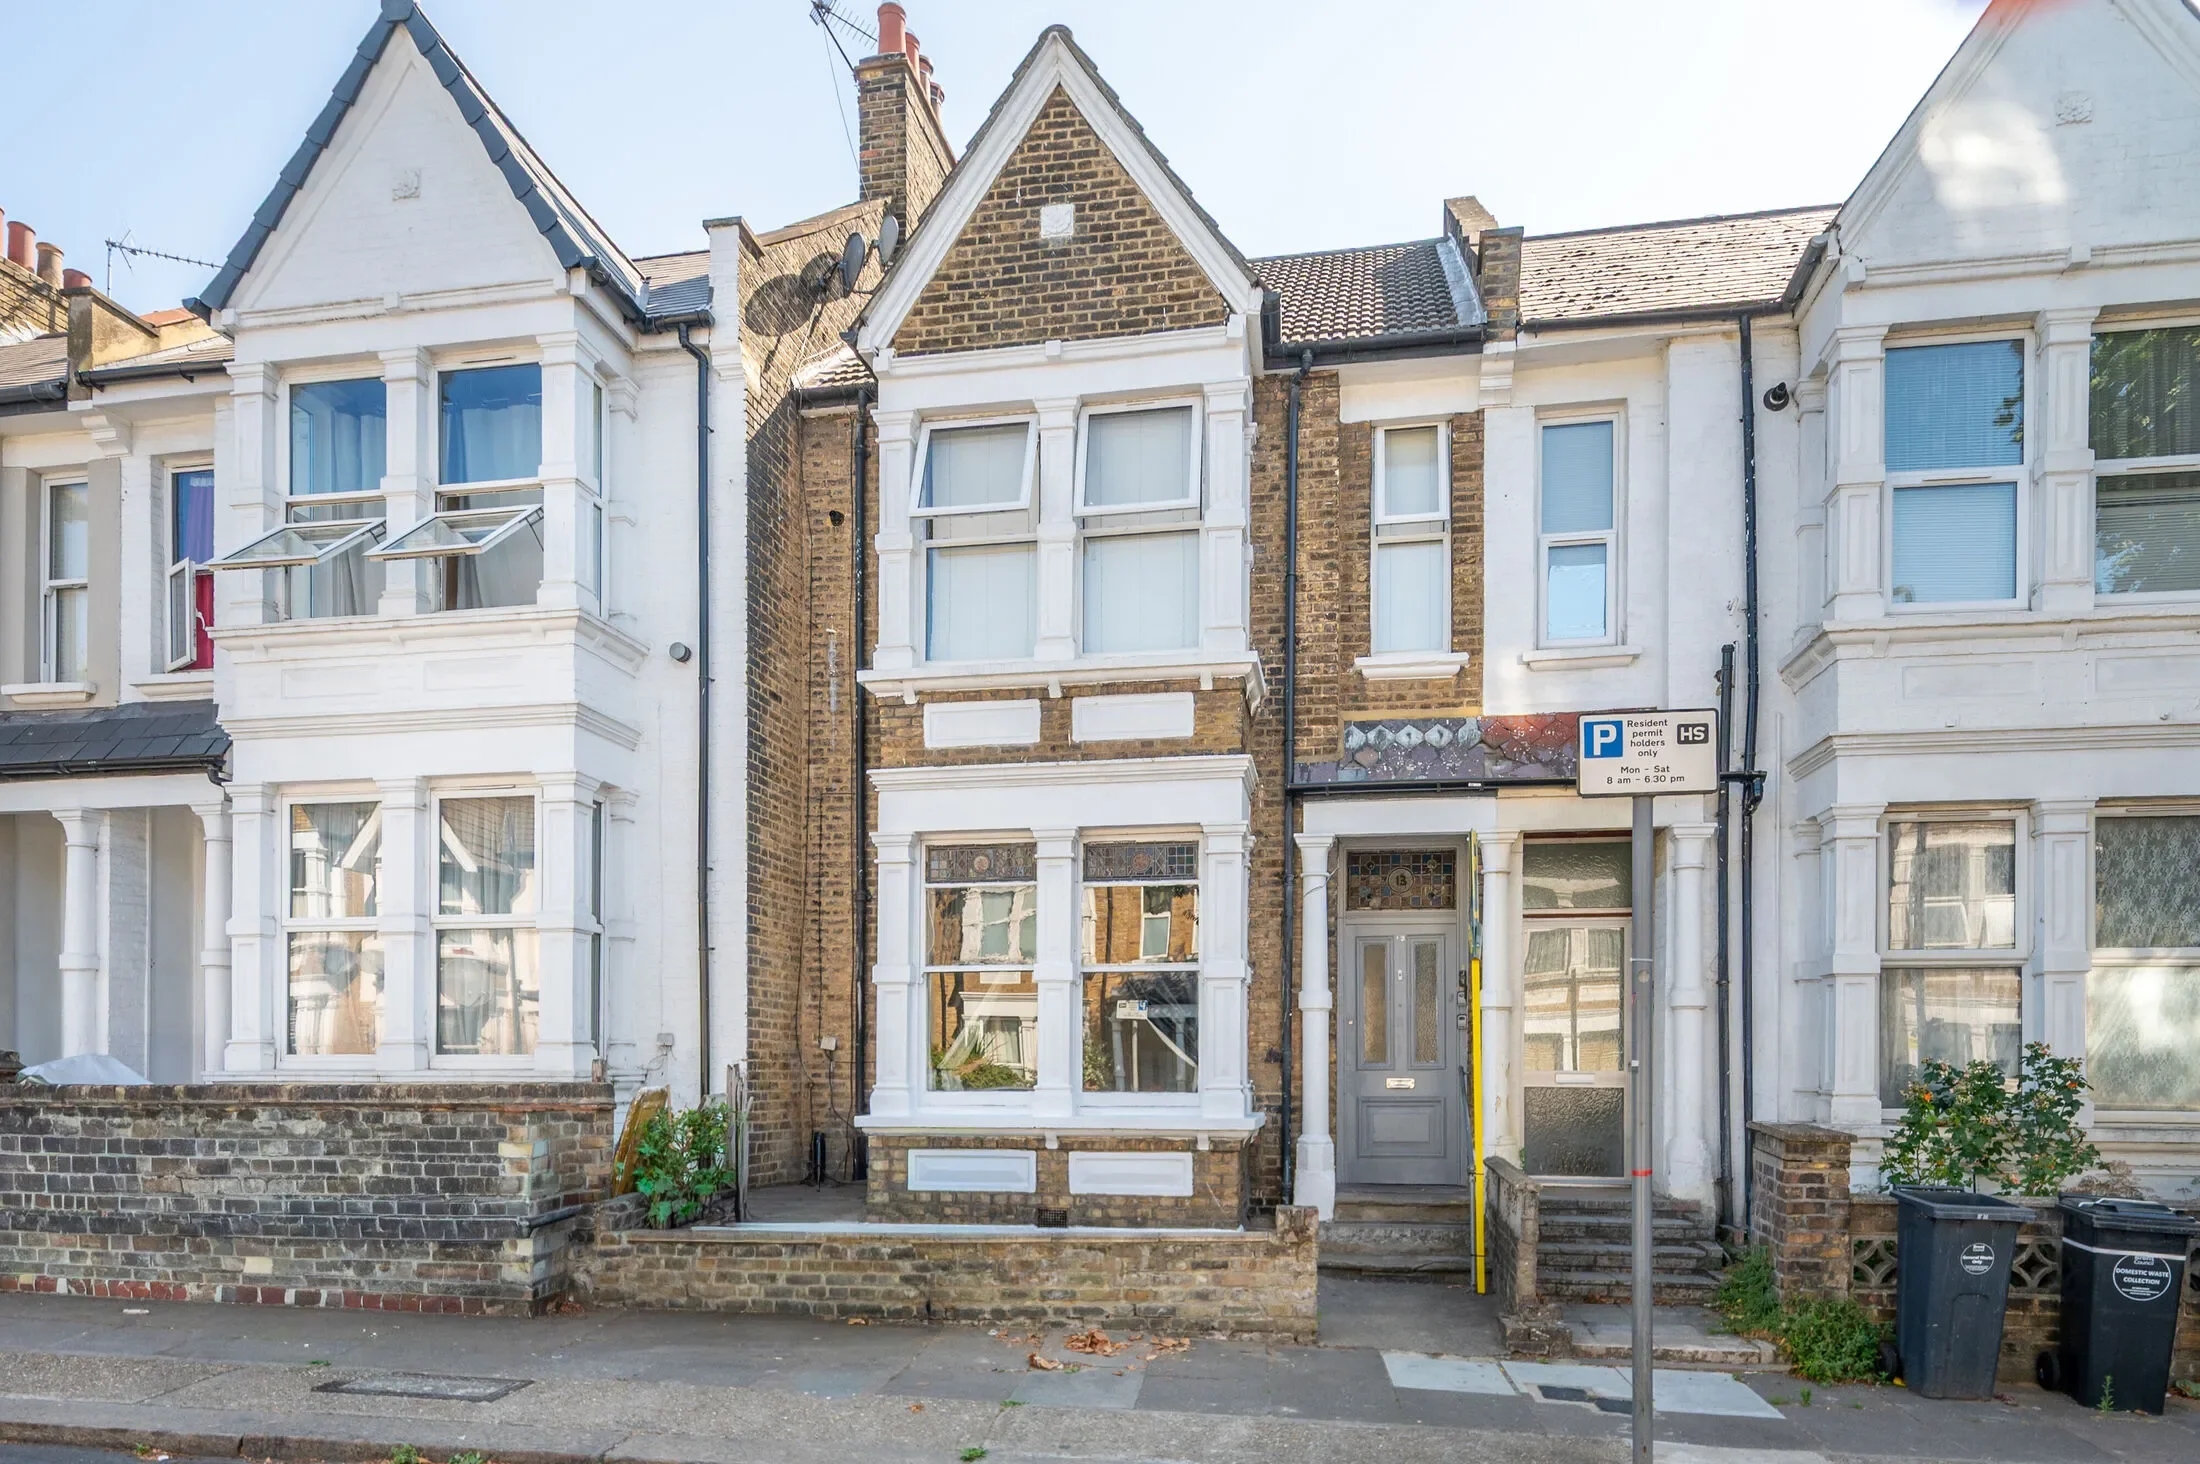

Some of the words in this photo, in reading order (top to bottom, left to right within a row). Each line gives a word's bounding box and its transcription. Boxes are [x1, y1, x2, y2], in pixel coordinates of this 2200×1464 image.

[1627, 719, 1668, 728] Resident
[1632, 728, 1663, 738] permit
[1680, 726, 1706, 741] HS
[1593, 724, 1617, 756] P
[1630, 739, 1665, 747] holders
[1637, 749, 1658, 757] only
[1620, 766, 1640, 774] Mon
[1654, 765, 1670, 773] Sat
[1606, 776, 1613, 784] 8
[1644, 775, 1666, 783] 6.30
[1670, 775, 1685, 783] pm
[1395, 874, 1408, 886] 13
[2115, 1267, 2148, 1276] DOMESTIC
[2148, 1270, 2169, 1278] WASTE
[2123, 1276, 2160, 1285] COLLECTION
